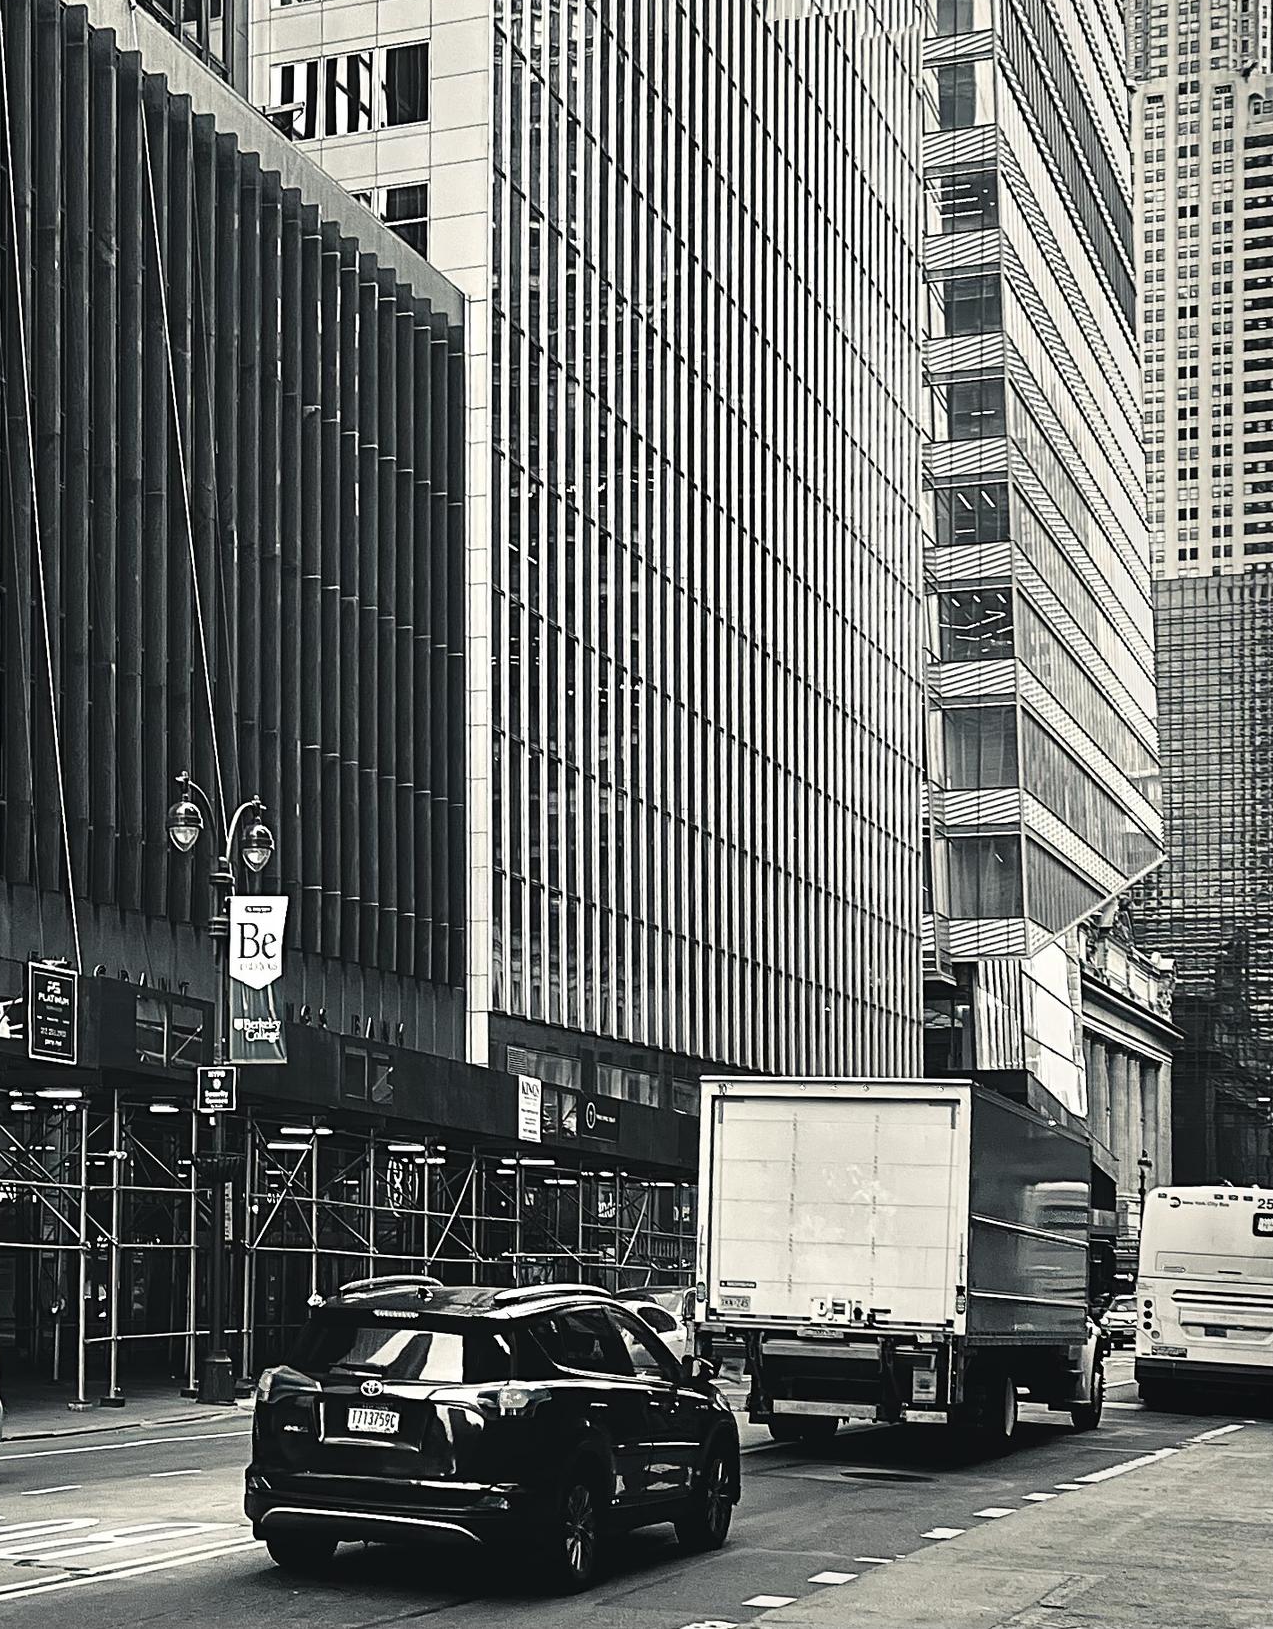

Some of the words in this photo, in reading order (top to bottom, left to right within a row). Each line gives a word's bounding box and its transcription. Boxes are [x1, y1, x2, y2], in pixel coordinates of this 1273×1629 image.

[236, 922, 277, 960] Be
[243, 1017, 282, 1032] Berkeley
[245, 1029, 280, 1044] College
